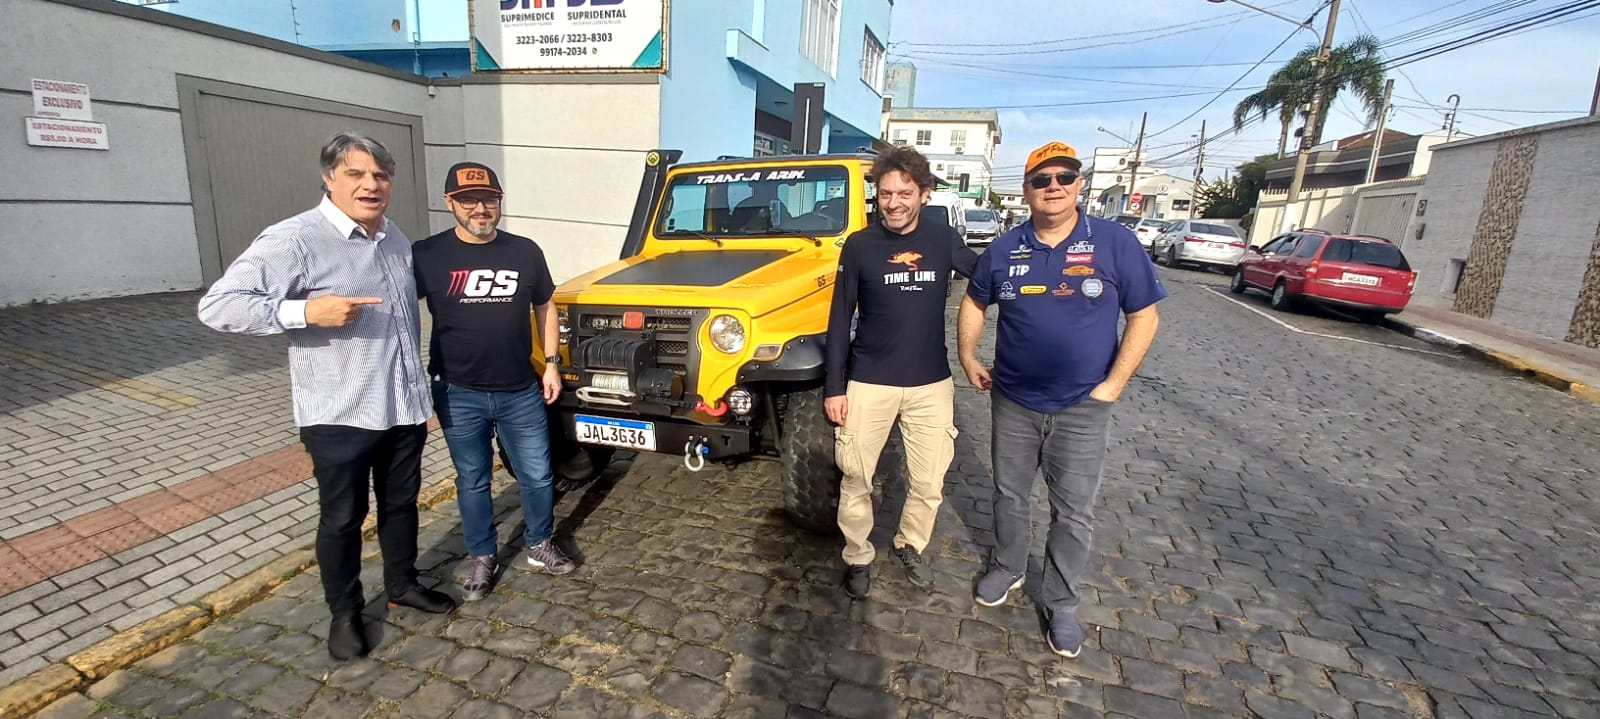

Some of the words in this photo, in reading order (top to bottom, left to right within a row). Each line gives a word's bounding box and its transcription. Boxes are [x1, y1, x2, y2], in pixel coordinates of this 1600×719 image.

[501, 12, 555, 22] SUPRIMEDICE
[567, 9, 627, 20] SUPRIDENTAL
[516, 34, 559, 44] 3223-2066
[567, 32, 613, 43] 3223-8303
[540, 47, 587, 56] 99174-2034
[42, 96, 84, 110] EXCLUSIVO
[32, 122, 102, 135] ESTACIONAMENTO
[76, 136, 98, 145] HORA
[466, 170, 485, 180] GS
[883, 271, 910, 285] TIME
[914, 270, 936, 282] LINE
[583, 424, 646, 446] JAL3G36
